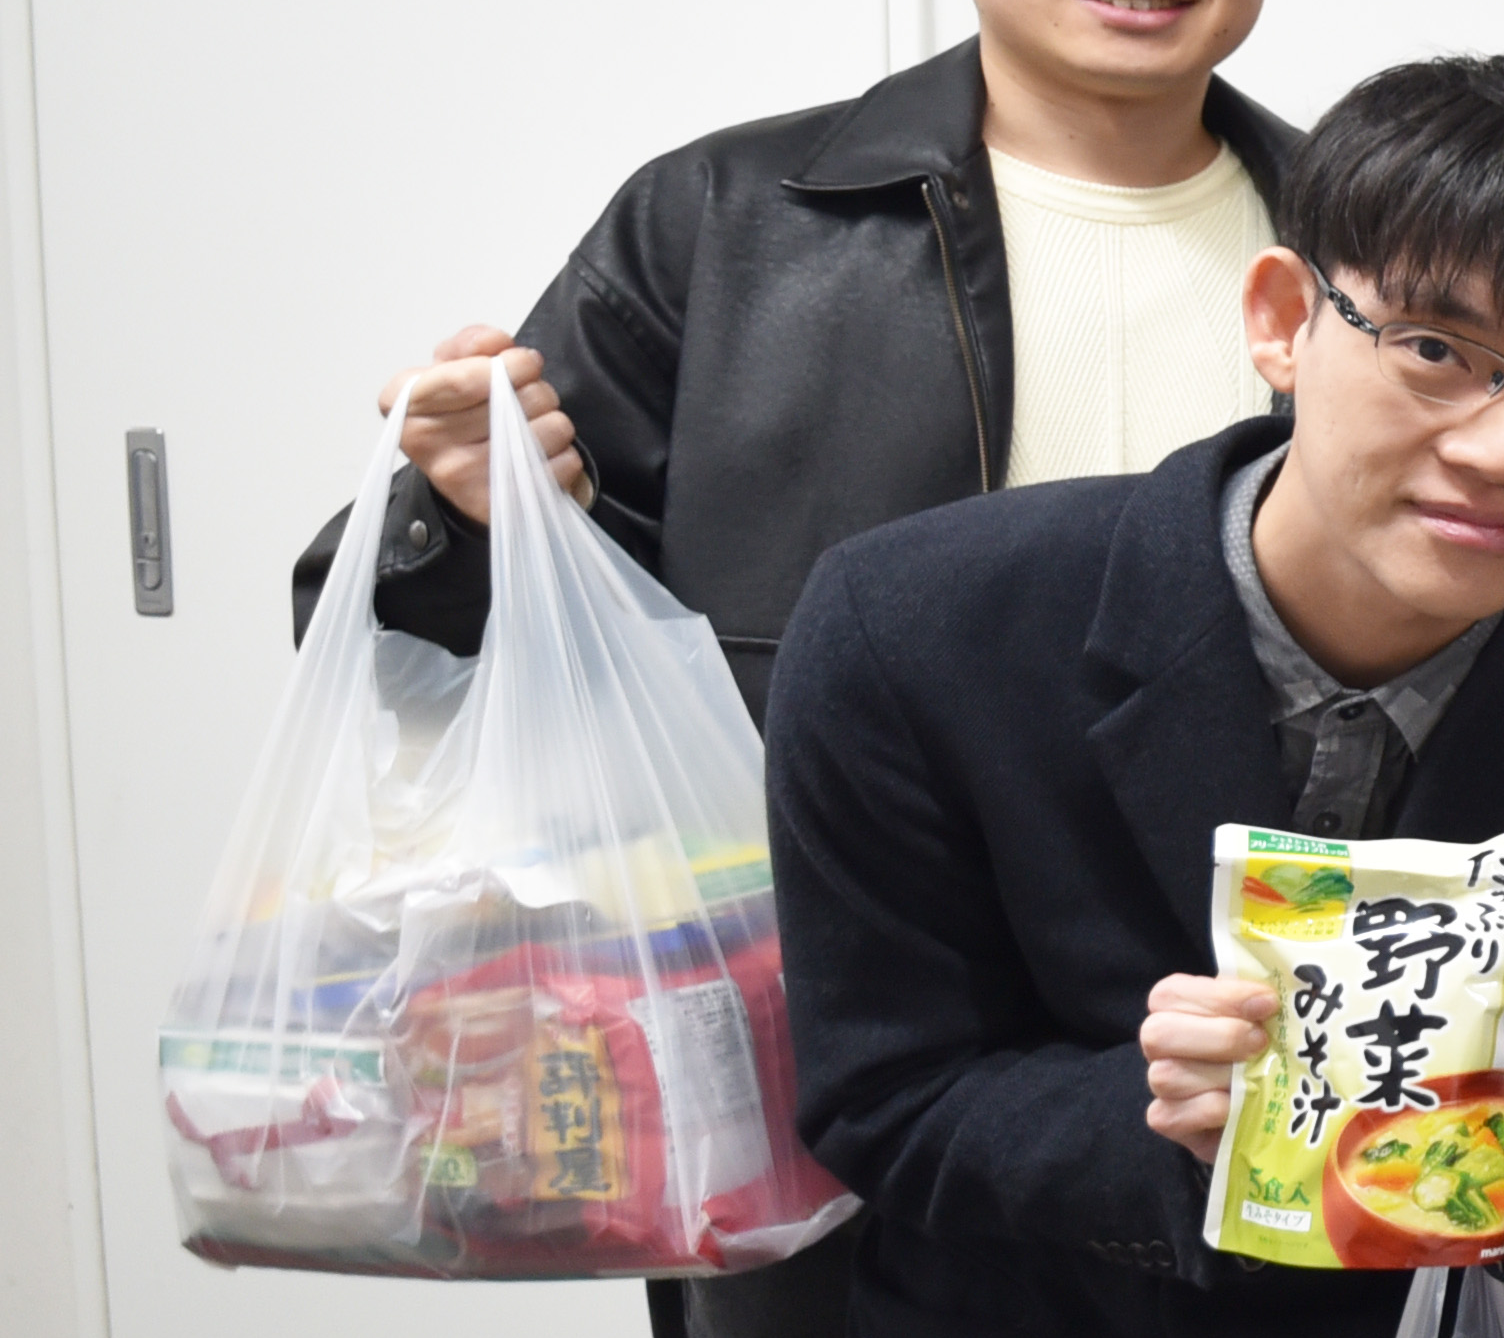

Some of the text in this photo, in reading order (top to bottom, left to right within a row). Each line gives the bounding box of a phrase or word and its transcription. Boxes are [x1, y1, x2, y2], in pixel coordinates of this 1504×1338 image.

[1290, 964, 1345, 1144] みそ汁
[1346, 899, 1467, 1110] 野菜
[1249, 1167, 1311, 1206] 5食入
